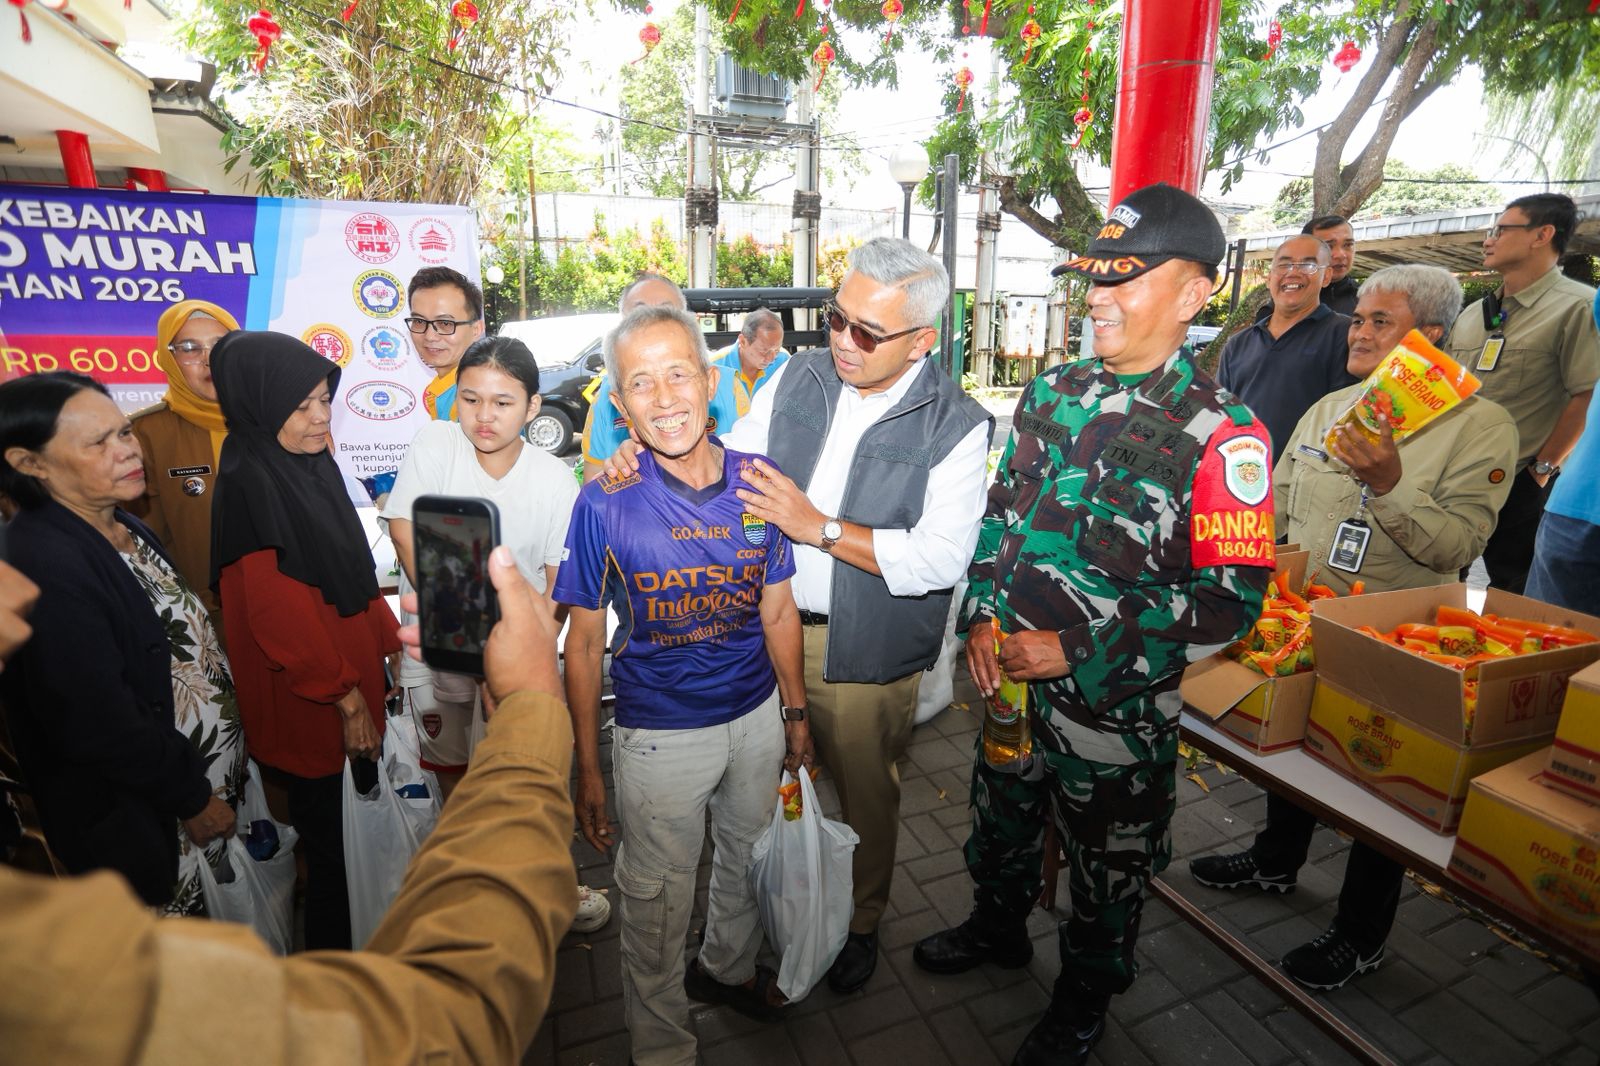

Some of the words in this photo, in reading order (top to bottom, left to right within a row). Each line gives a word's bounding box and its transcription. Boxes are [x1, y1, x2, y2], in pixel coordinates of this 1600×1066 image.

[42, 233, 257, 276] MURAH
[90, 276, 185, 303] 2026
[0, 348, 59, 373] Rp
[1389, 356, 1417, 385] ROSE
[1408, 378, 1447, 411] BRAND
[340, 443, 371, 452] Bawa
[374, 442, 410, 454] Kupon
[1109, 446, 1139, 466] TNI
[363, 464, 398, 474] kupon
[645, 586, 757, 621] Indofood
[650, 619, 742, 647] PermataBank
[1347, 715, 1370, 734] ROSE
[1370, 728, 1403, 750] BRAND
[1529, 842, 1571, 869] ROSE
